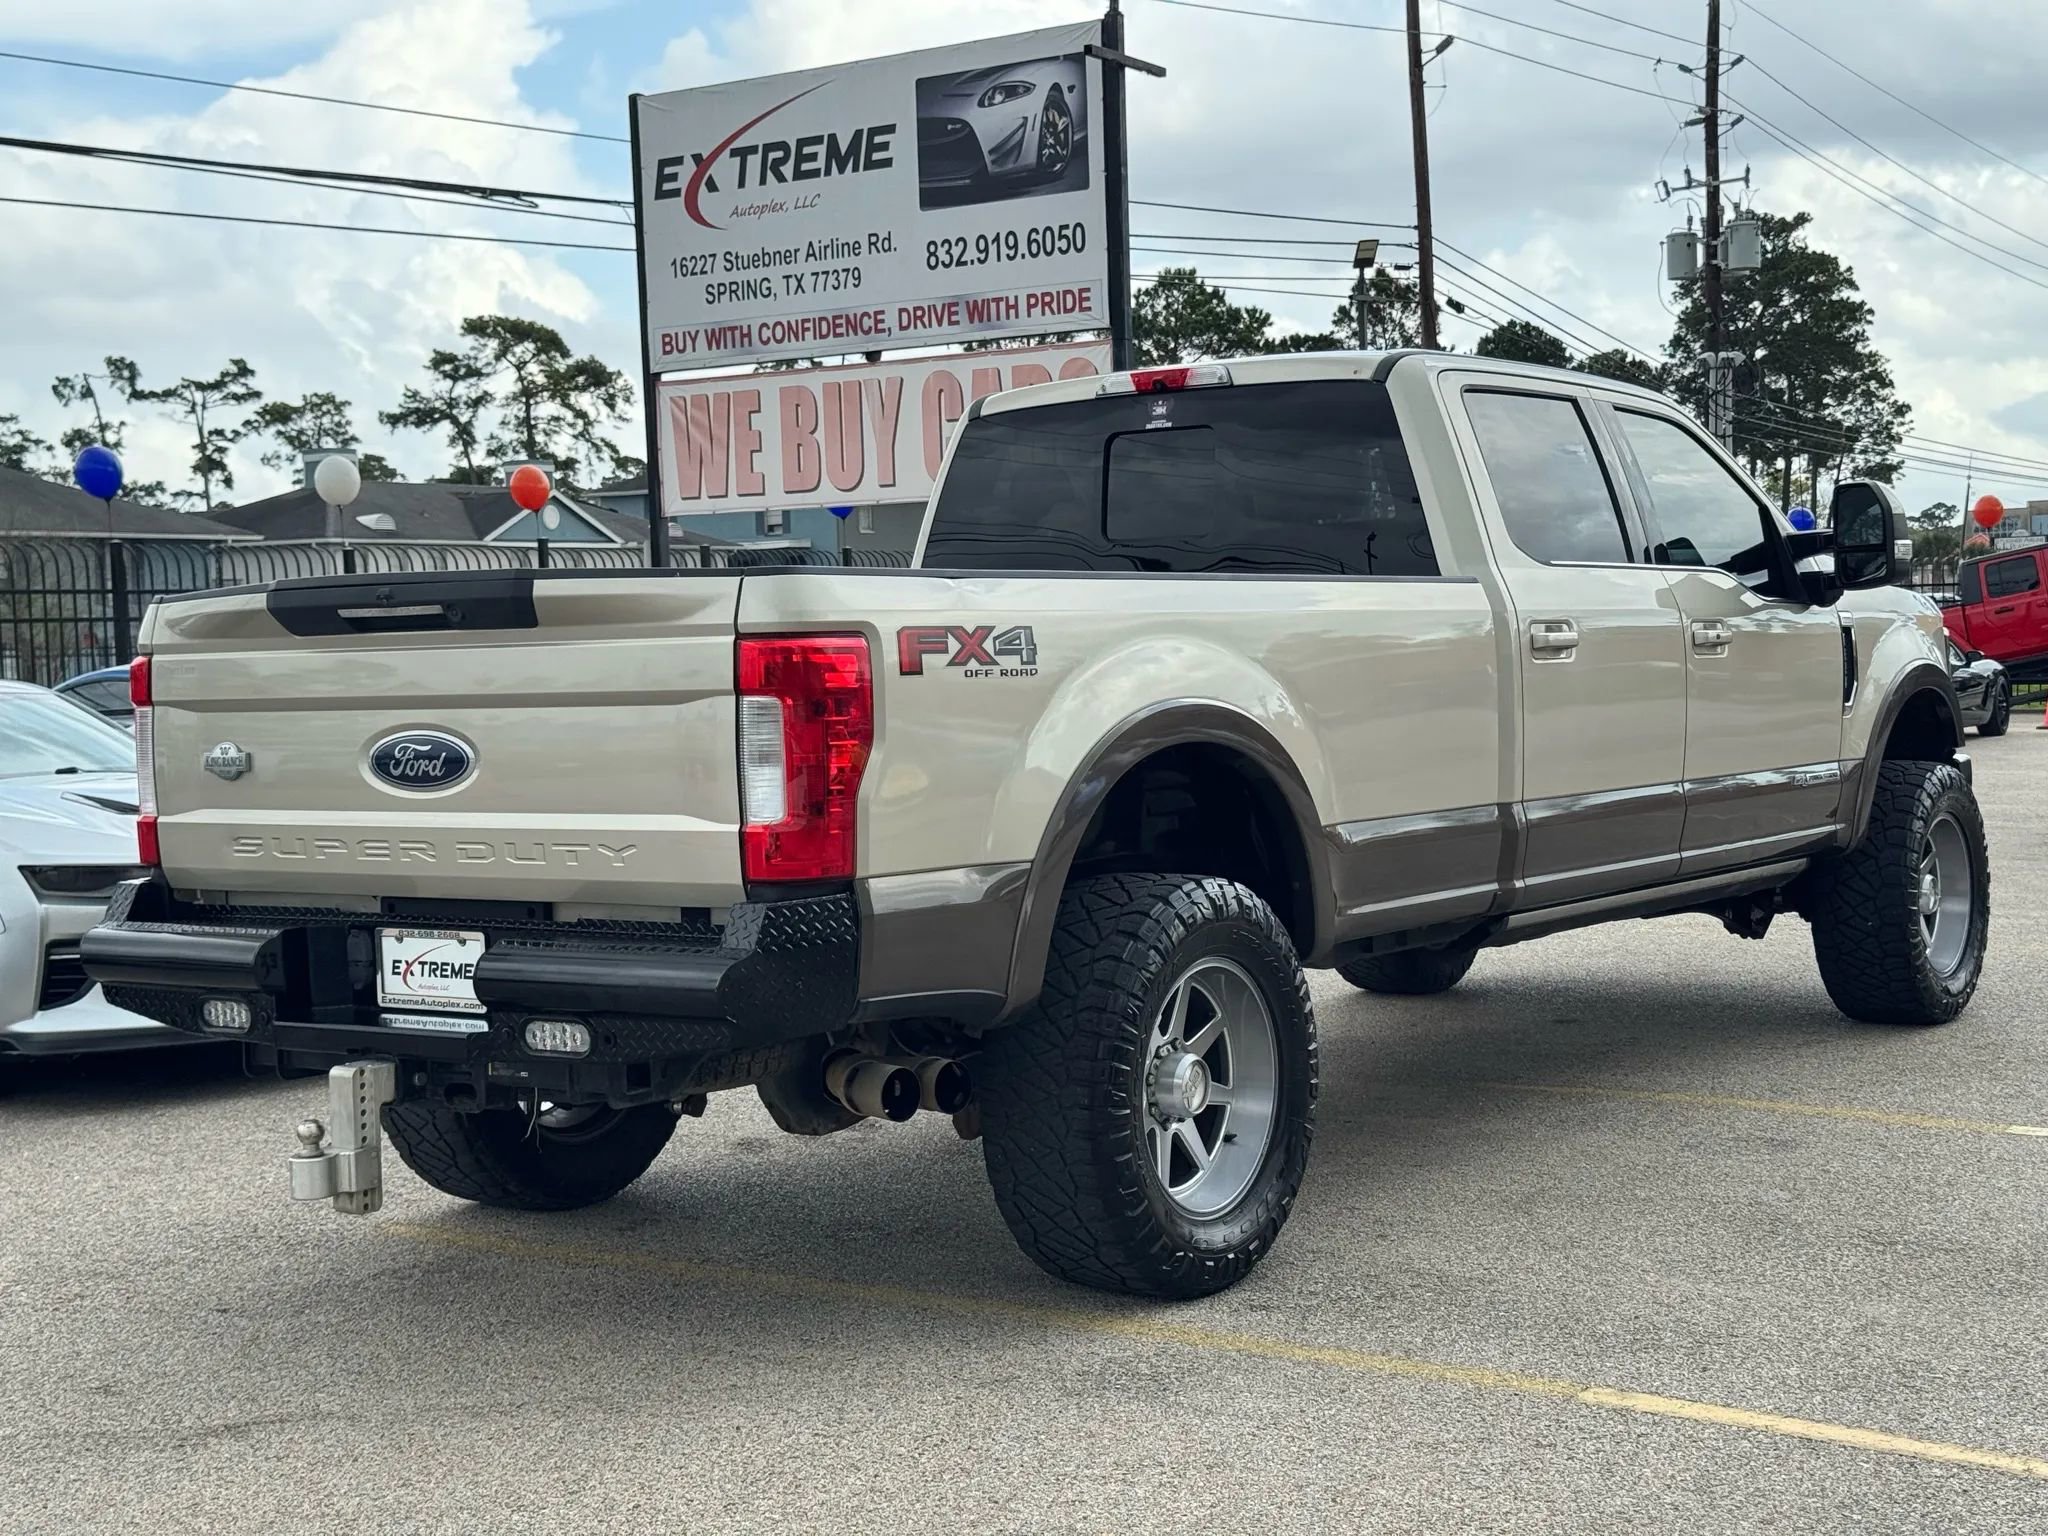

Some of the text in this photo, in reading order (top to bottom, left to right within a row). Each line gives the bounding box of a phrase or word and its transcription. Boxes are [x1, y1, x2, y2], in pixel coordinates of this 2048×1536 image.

[654, 123, 897, 201] EXTREME
[729, 194, 821, 220] Autoplex, LLC
[671, 231, 897, 279] 16227 Stuebner Airline Rd.
[926, 222, 1086, 271] 832.919.6050
[705, 267, 862, 305] SPRING, TX 77379
[661, 287, 1092, 356] BUY WITH CONFIDENCE, DRIVE WITH PRIDE
[669, 389, 765, 499] WE
[779, 375, 903, 494] BUY
[896, 625, 1038, 675] FX4
[964, 668, 1039, 678] OFF ROAD
[389, 743, 447, 777] Ford
[232, 836, 637, 866] SUPER DUTY
[391, 959, 475, 981] EXTREME
[381, 995, 484, 1010] ExtremeAutoplex.com
